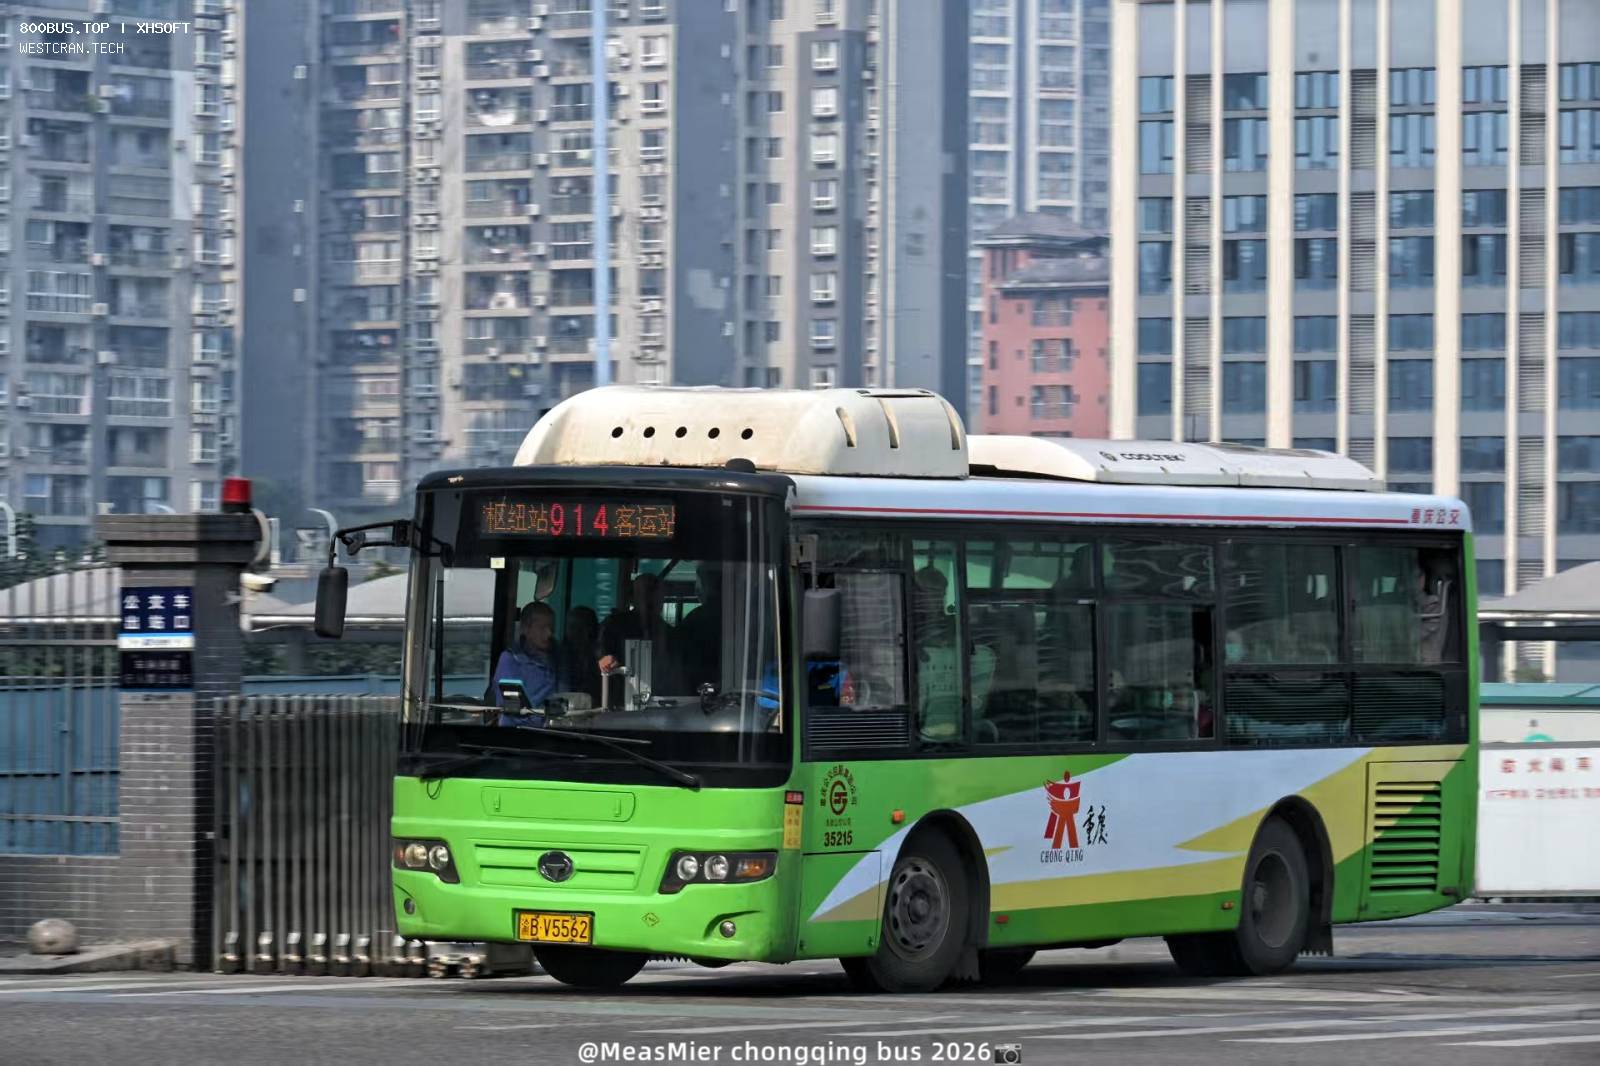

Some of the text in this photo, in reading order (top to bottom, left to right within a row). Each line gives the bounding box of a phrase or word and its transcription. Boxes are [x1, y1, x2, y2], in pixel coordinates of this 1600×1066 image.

[483, 502, 676, 537] 枢纽站 914 客运站
[1410, 508, 1460, 525] 重庆公交
[123, 594, 190, 610] 公交车
[123, 615, 190, 630] 出站口
[823, 830, 853, 848] 35215
[1040, 849, 1084, 863] CHONG QING
